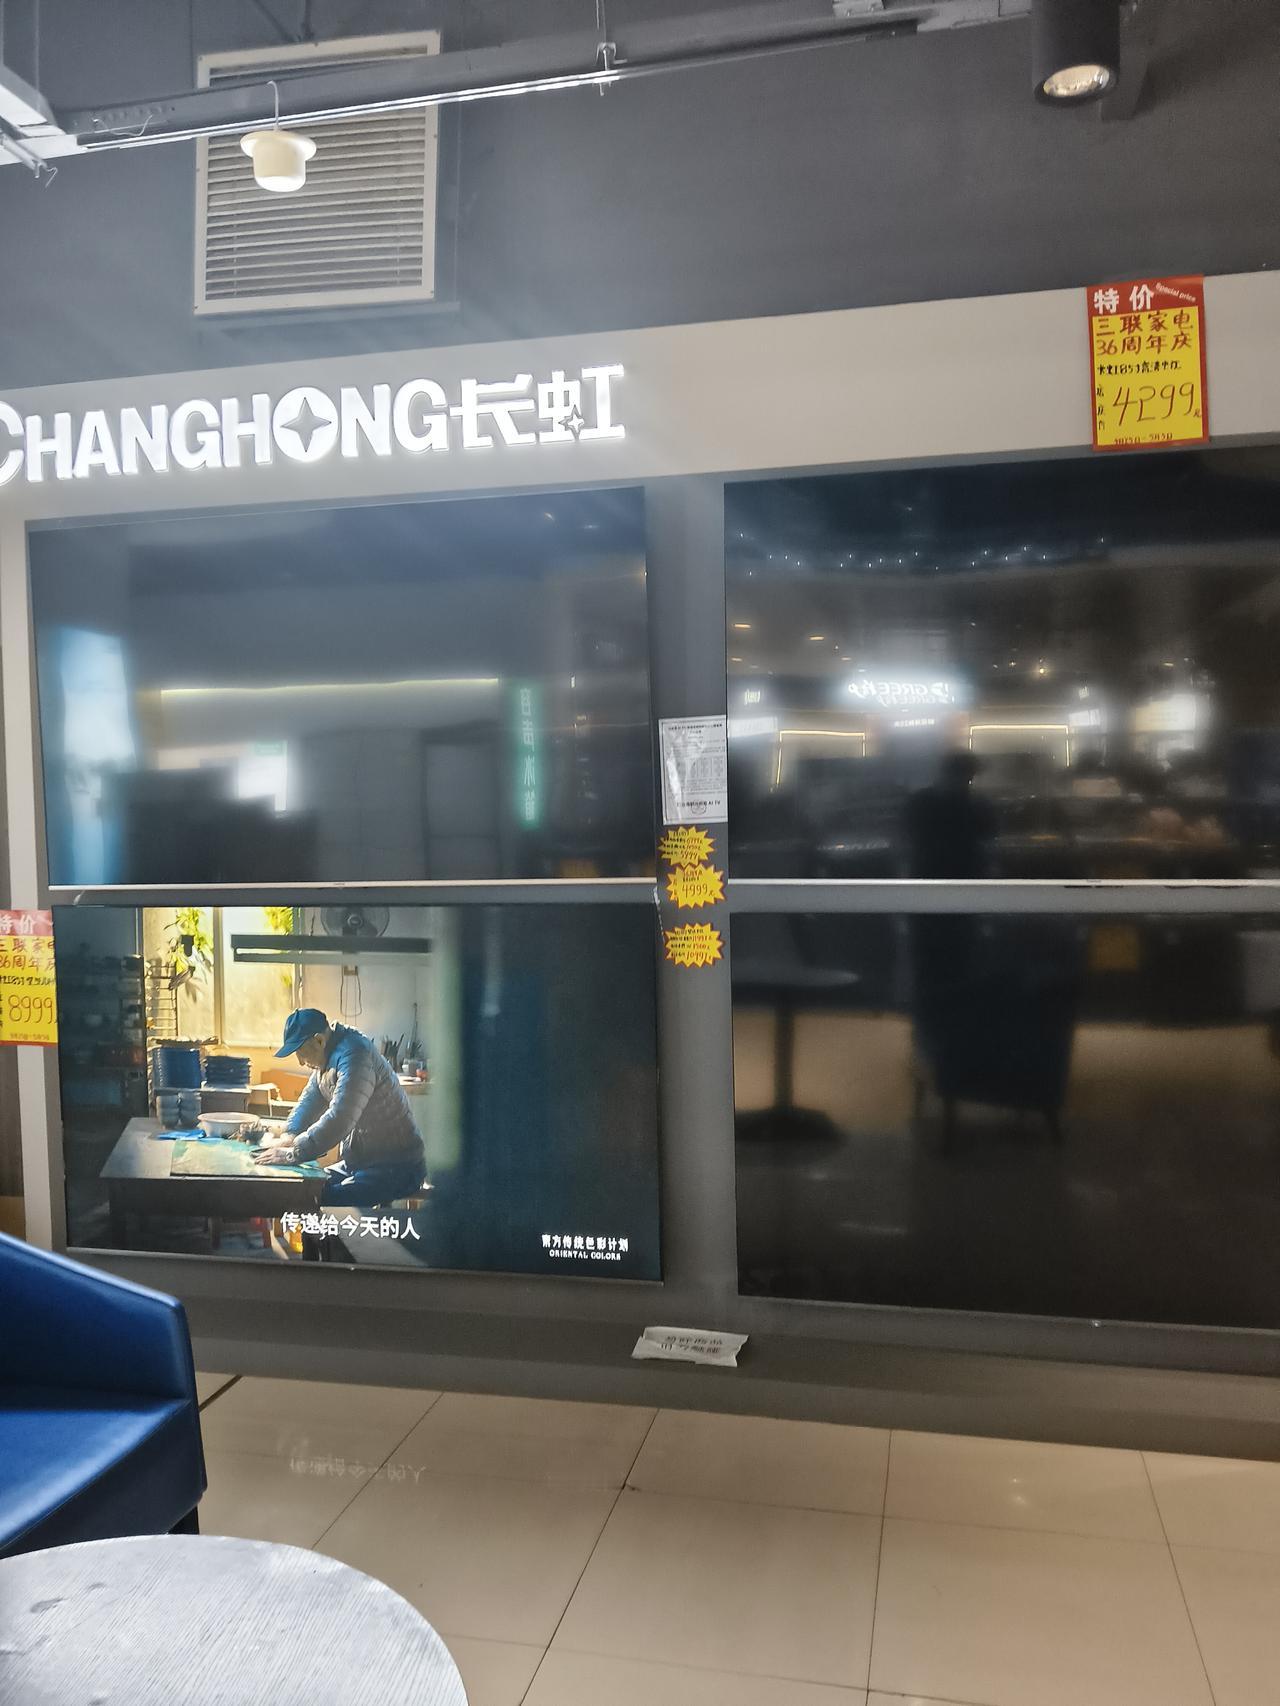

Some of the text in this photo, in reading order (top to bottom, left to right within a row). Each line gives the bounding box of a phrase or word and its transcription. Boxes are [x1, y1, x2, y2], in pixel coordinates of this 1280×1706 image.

[1093, 283, 1155, 314] 特价
[1179, 292, 1196, 302] price
[1096, 309, 1194, 336] 三联家电
[1096, 332, 1192, 356] 36周年庆
[448, 363, 626, 449] 长虹
[8, 994, 53, 1024] 8999
[280, 1211, 421, 1240] 传递给今天的人
